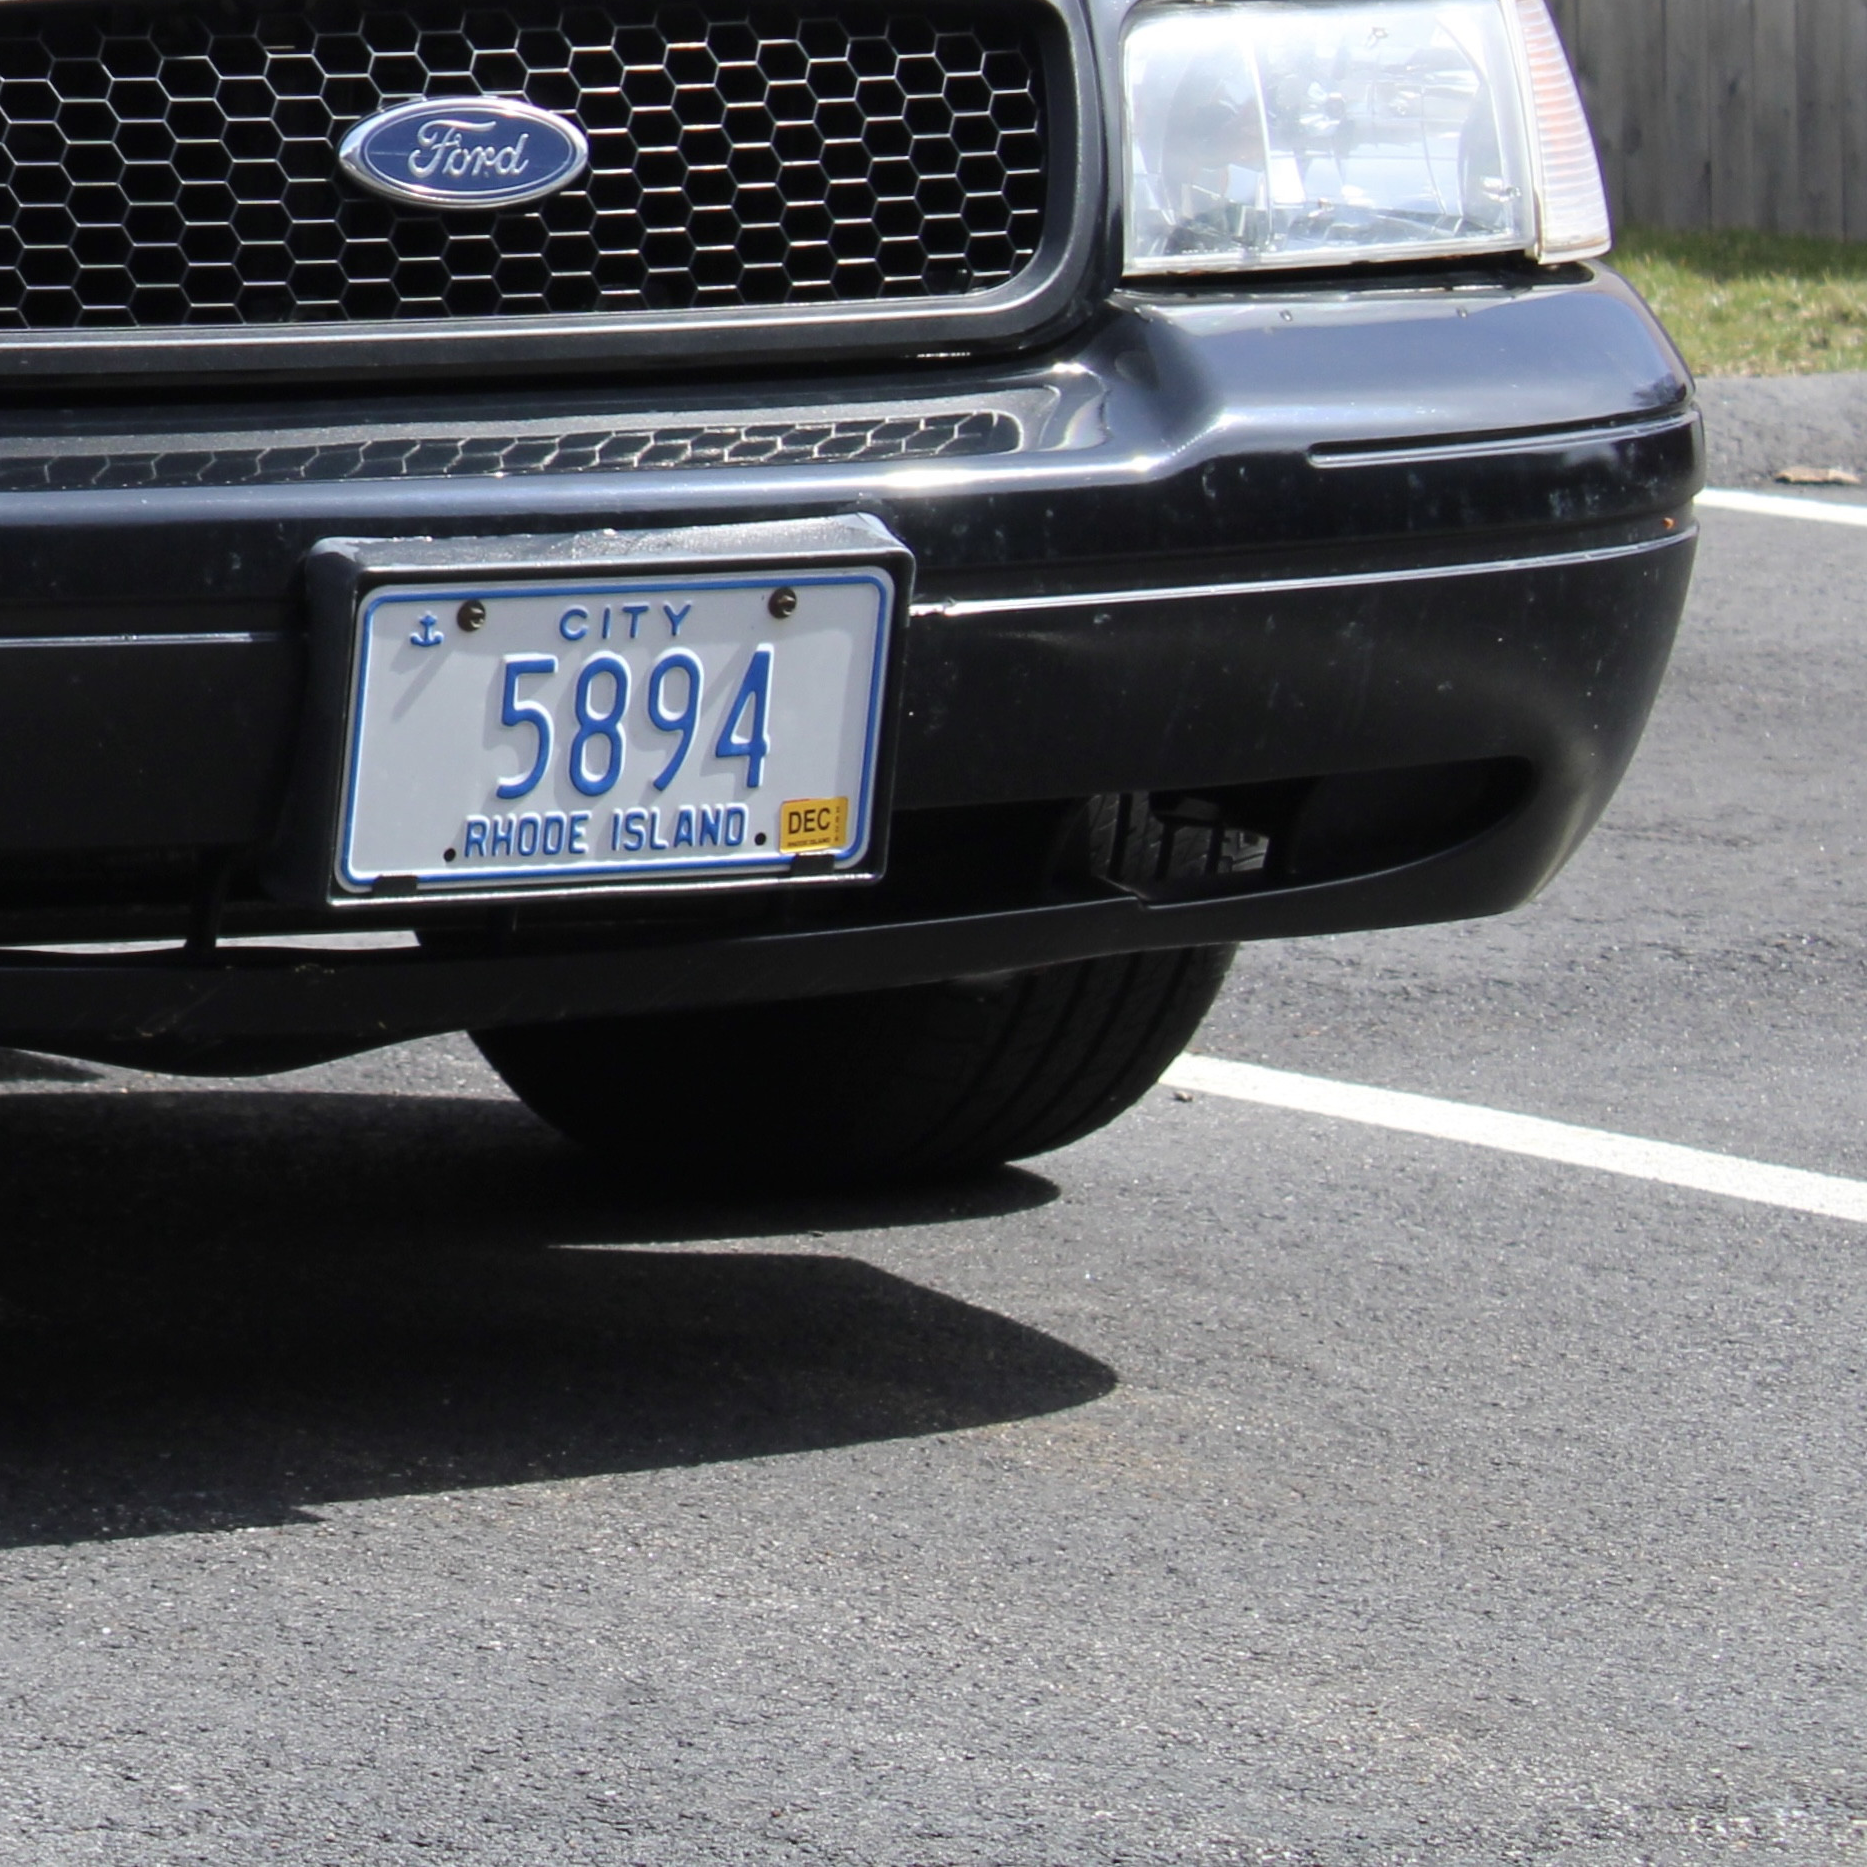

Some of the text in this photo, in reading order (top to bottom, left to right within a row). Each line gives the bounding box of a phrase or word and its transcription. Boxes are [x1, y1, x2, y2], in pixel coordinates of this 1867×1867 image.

[407, 119, 529, 178] Ford
[558, 601, 695, 642] CITY
[495, 643, 775, 800] 5894
[464, 802, 749, 858] RHODE ISLAND
[788, 807, 831, 835] DEC
